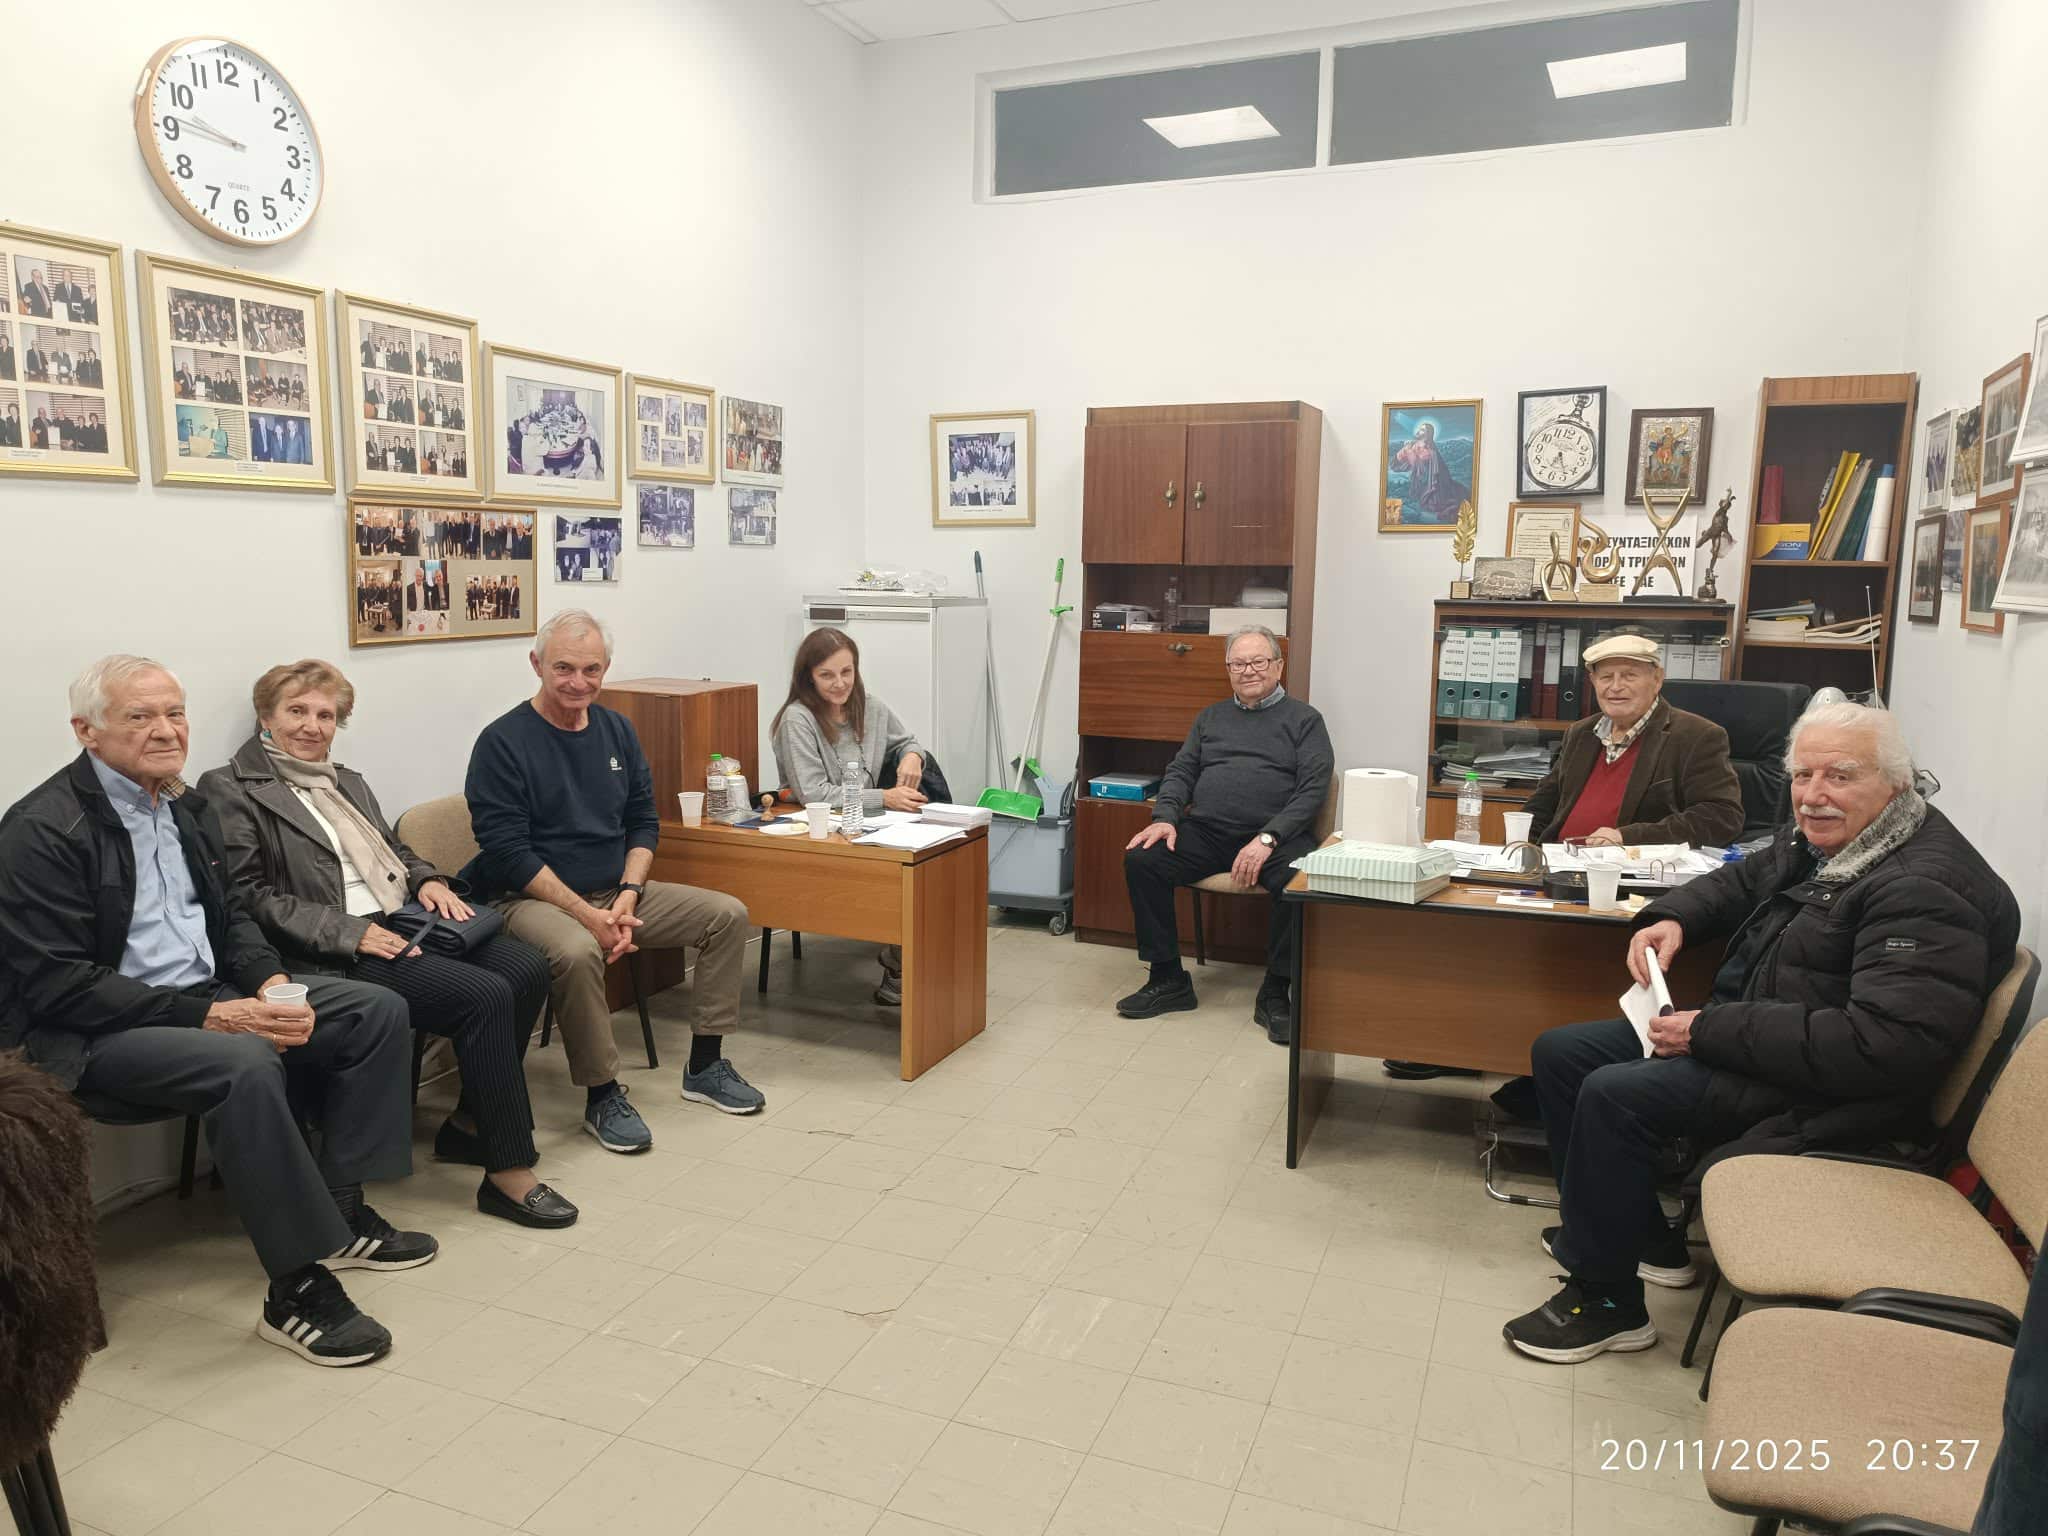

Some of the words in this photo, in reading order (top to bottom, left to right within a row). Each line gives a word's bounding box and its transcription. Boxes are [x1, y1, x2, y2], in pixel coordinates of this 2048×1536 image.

[191, 62, 208, 89] 11
[216, 59, 239, 87] 12
[170, 82, 193, 110] 10
[253, 79, 260, 103] 1
[162, 115, 180, 141] 9
[272, 106, 289, 132] 2
[176, 154, 193, 179] 8
[286, 145, 301, 170] 3
[205, 184, 221, 210] 7
[280, 177, 296, 201] 4
[233, 199, 250, 224] 6
[262, 195, 278, 221] 5
[1541, 433, 1553, 443] 10
